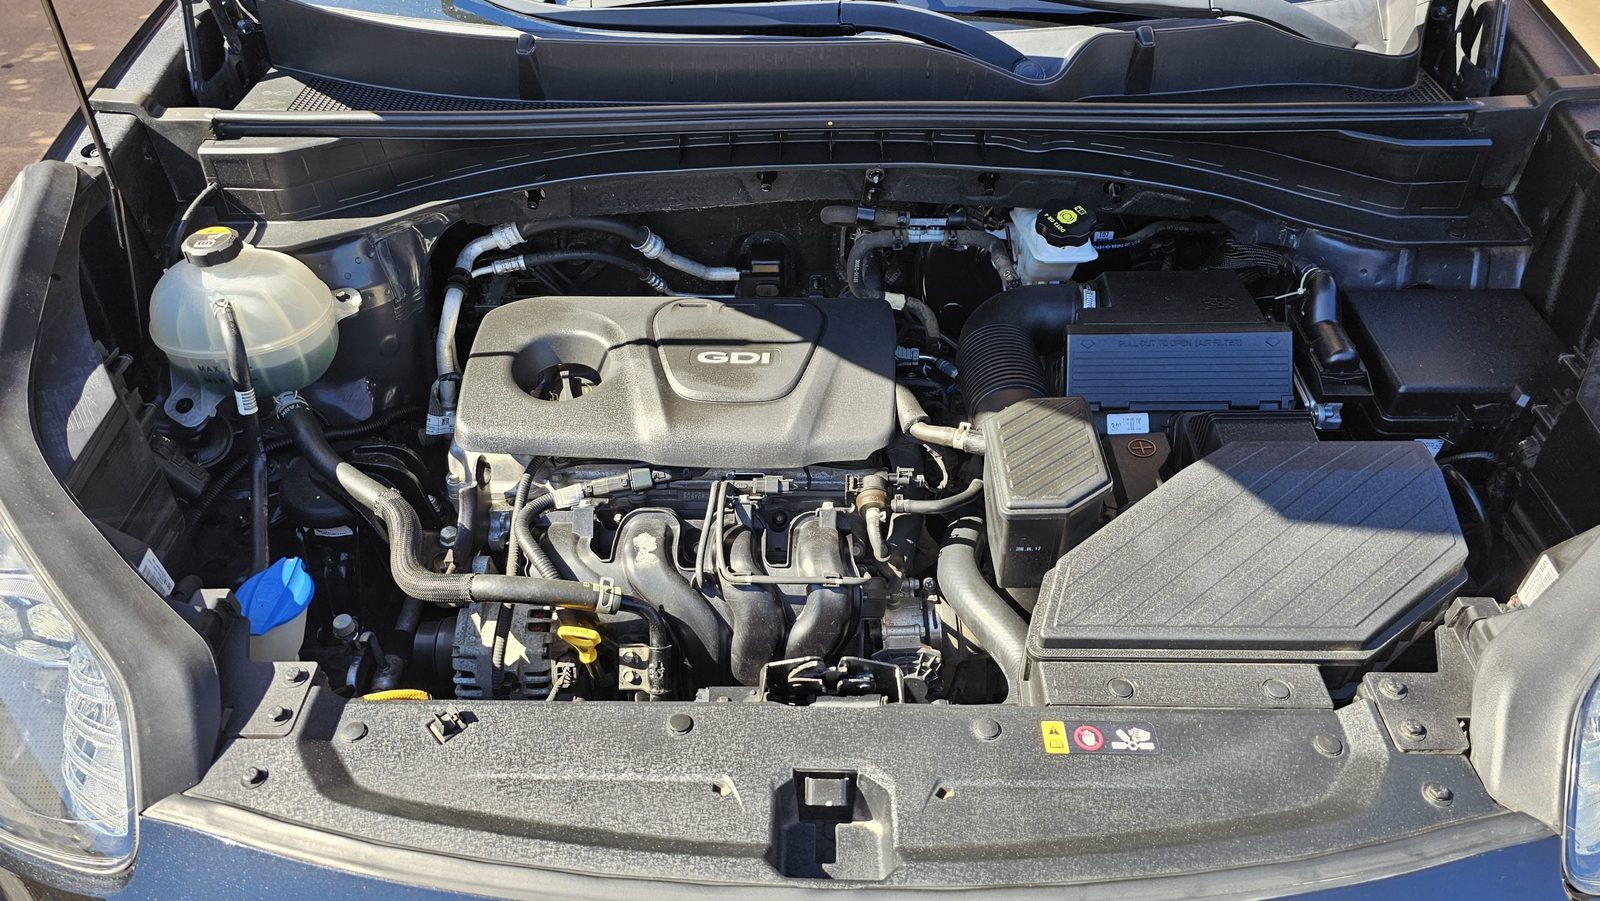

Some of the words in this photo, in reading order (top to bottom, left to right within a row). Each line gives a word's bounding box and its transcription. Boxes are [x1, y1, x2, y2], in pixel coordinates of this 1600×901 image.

[1119, 340, 1139, 348] PULL
[1140, 340, 1155, 348] OUT
[1158, 339, 1169, 347] TO
[1170, 339, 1192, 347] OPEN
[697, 351, 771, 364] GDI
[197, 364, 219, 373] MAX
[281, 403, 301, 418] TANK
